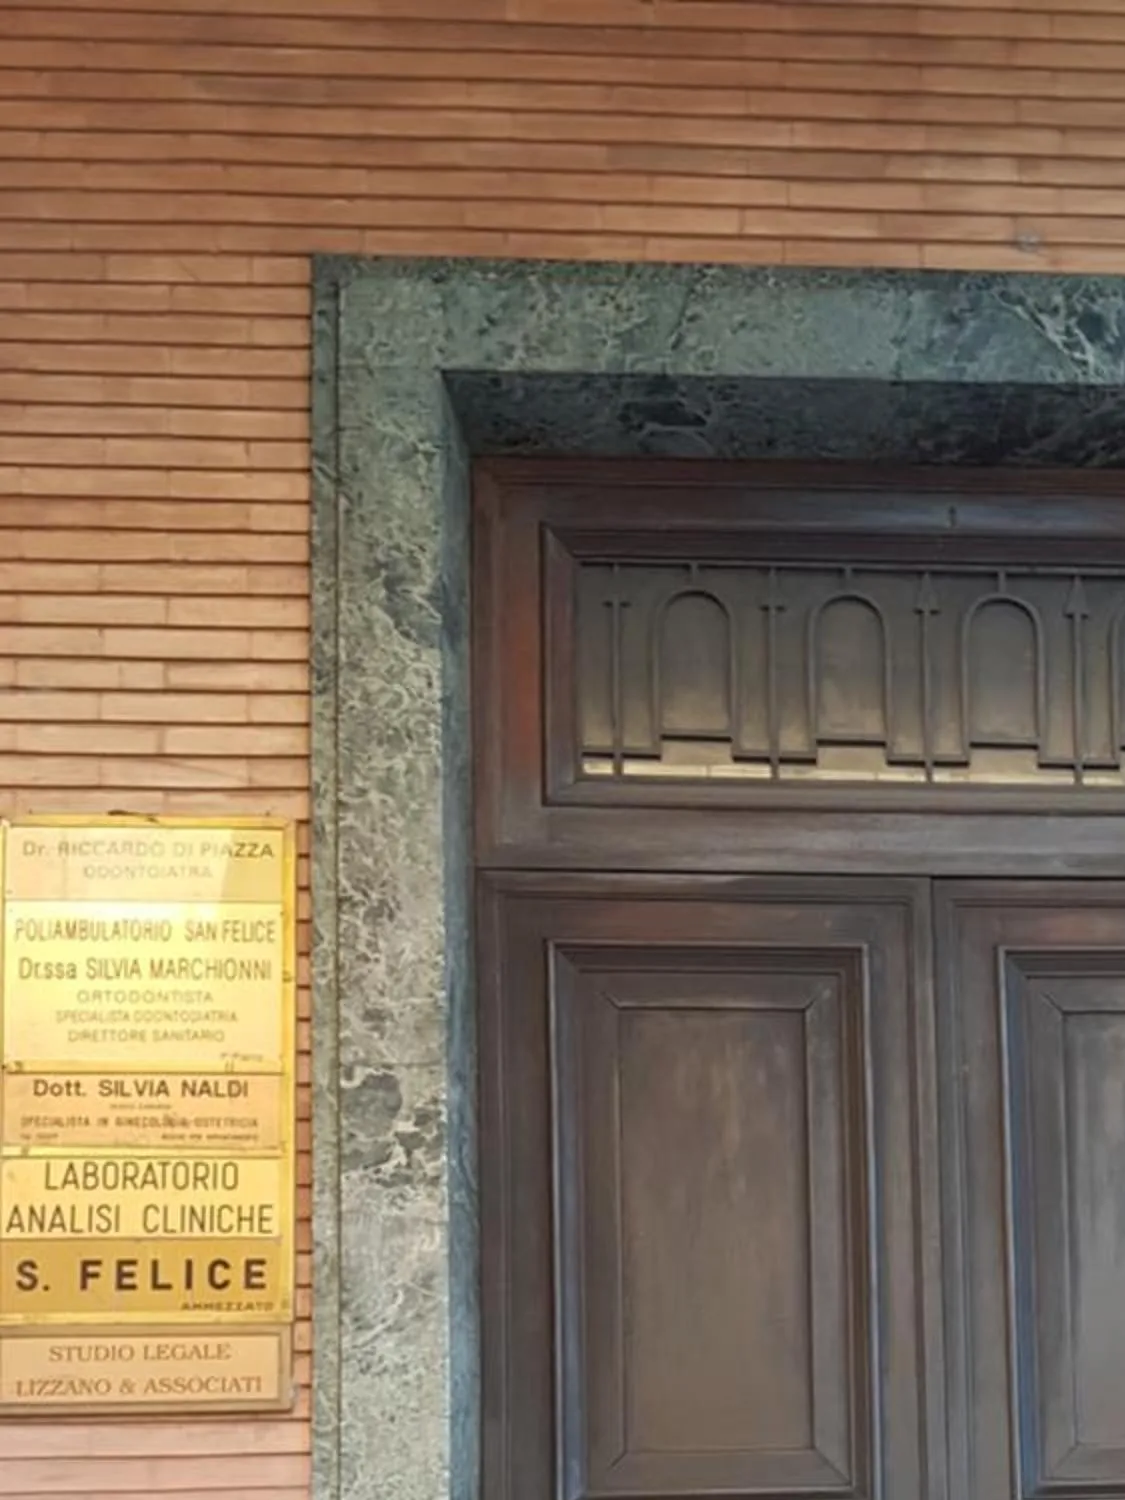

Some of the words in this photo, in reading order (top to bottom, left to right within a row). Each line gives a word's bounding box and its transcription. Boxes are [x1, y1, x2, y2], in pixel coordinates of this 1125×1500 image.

[22, 841, 48, 857] Dr.
[58, 840, 166, 857] RICCARDO
[172, 841, 194, 857] DI
[200, 842, 274, 858] PIAZZA
[14, 918, 172, 942] POLIAMBULATORIO
[184, 919, 217, 942] SAN
[222, 919, 276, 943] FELICE
[86, 957, 142, 980] SILVIA
[149, 957, 272, 981] MARCHIONNI
[77, 989, 214, 1005] ORTODONTISTA
[32, 1079, 87, 1097] Dott.
[98, 1079, 170, 1098] SILVIA
[181, 1080, 249, 1098] NALDI
[44, 1161, 240, 1190] LABORATORIO
[6, 1204, 121, 1233] ANALISI
[142, 1203, 274, 1234] CLINICHE
[15, 1259, 50, 1291] S.
[79, 1259, 268, 1291] FELICE
[49, 1345, 135, 1363] STUDIO
[144, 1343, 232, 1361] LEGALE
[15, 1378, 112, 1398] LIZZANO
[119, 1378, 135, 1396] &
[143, 1375, 263, 1395] ASSOCIATI
